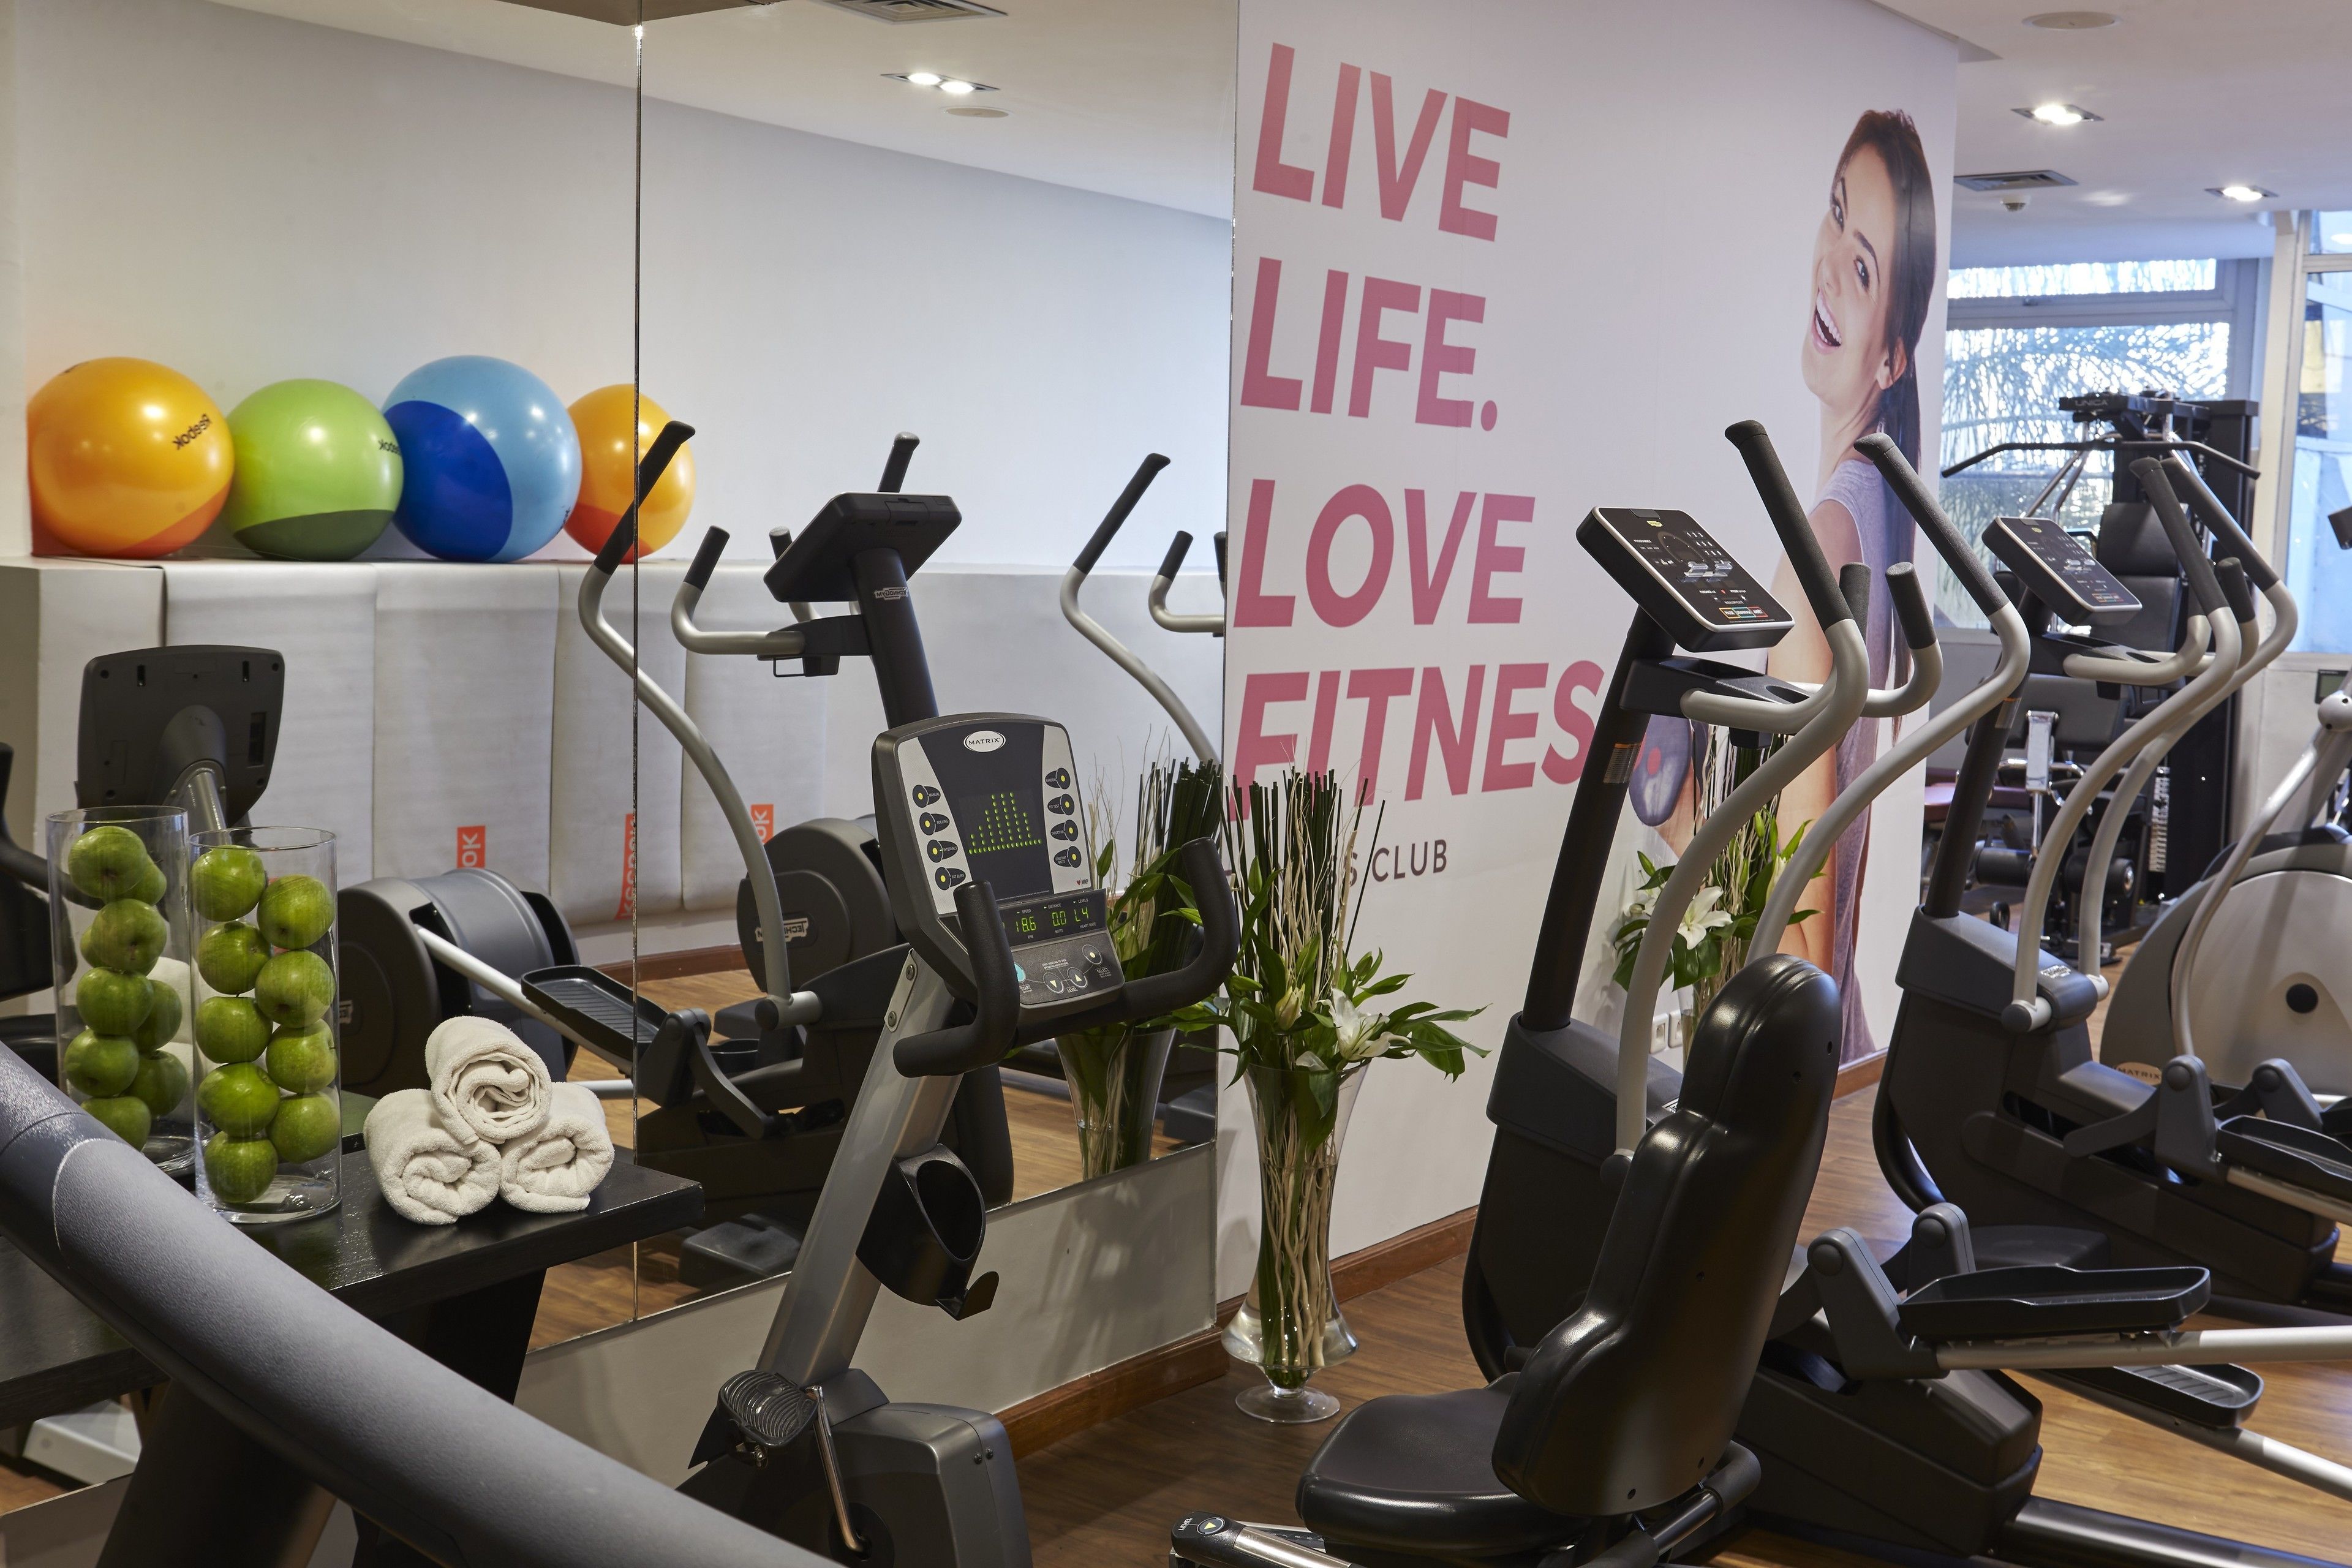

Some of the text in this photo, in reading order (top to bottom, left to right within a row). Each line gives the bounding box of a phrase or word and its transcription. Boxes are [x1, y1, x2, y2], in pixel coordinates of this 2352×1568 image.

[1253, 42, 1510, 242] LIVE
[1240, 256, 1498, 431] LIFE.
[1233, 478, 1536, 628] LOVE
[1228, 660, 1605, 821] FITNES
[1371, 839, 1447, 883] CLUB
[1178, 1517, 1193, 1531] LEVEL
